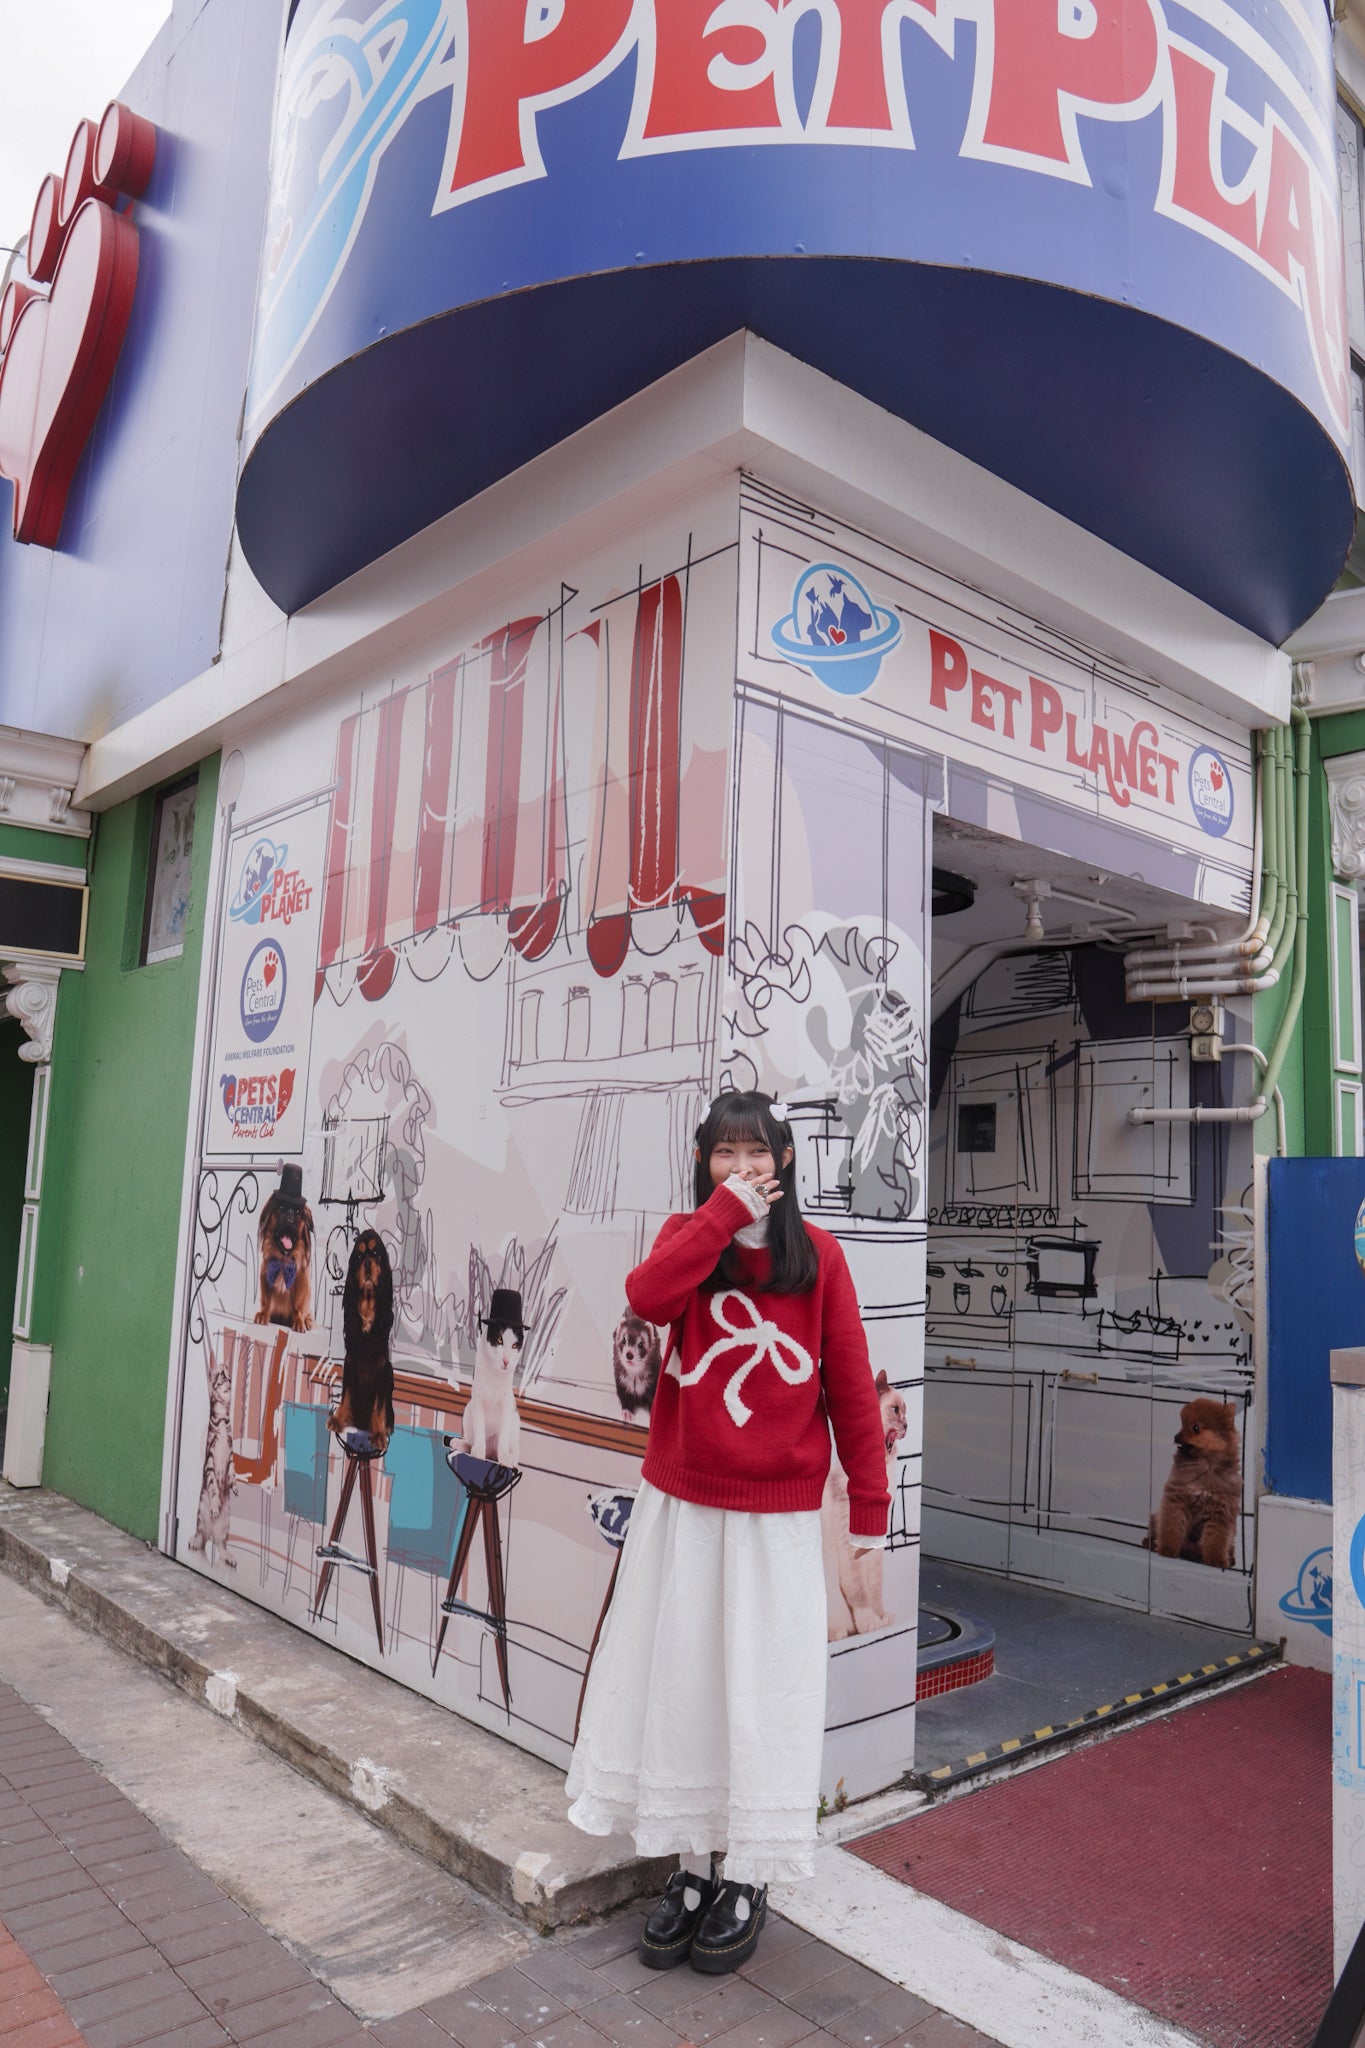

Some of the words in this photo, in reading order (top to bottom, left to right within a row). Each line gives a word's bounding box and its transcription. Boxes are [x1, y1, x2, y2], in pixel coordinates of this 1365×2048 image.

[928, 627, 1023, 741] PET
[1028, 674, 1180, 809] PLANET
[1193, 768, 1211, 792] Pets
[1197, 788, 1226, 812] Central
[271, 868, 300, 898] PET
[259, 878, 313, 926] PLANET
[246, 977, 263, 997] Pets
[248, 989, 277, 1013] Central
[223, 1051, 242, 1061] ANIMAL
[242, 1048, 263, 1060] WELFARE
[263, 1043, 296, 1057] FOUNDATION
[236, 1074, 278, 1107] PETS
[234, 1104, 276, 1125] CENTRAL
[231, 1120, 259, 1140] Parents
[259, 1120, 275, 1139] Club
